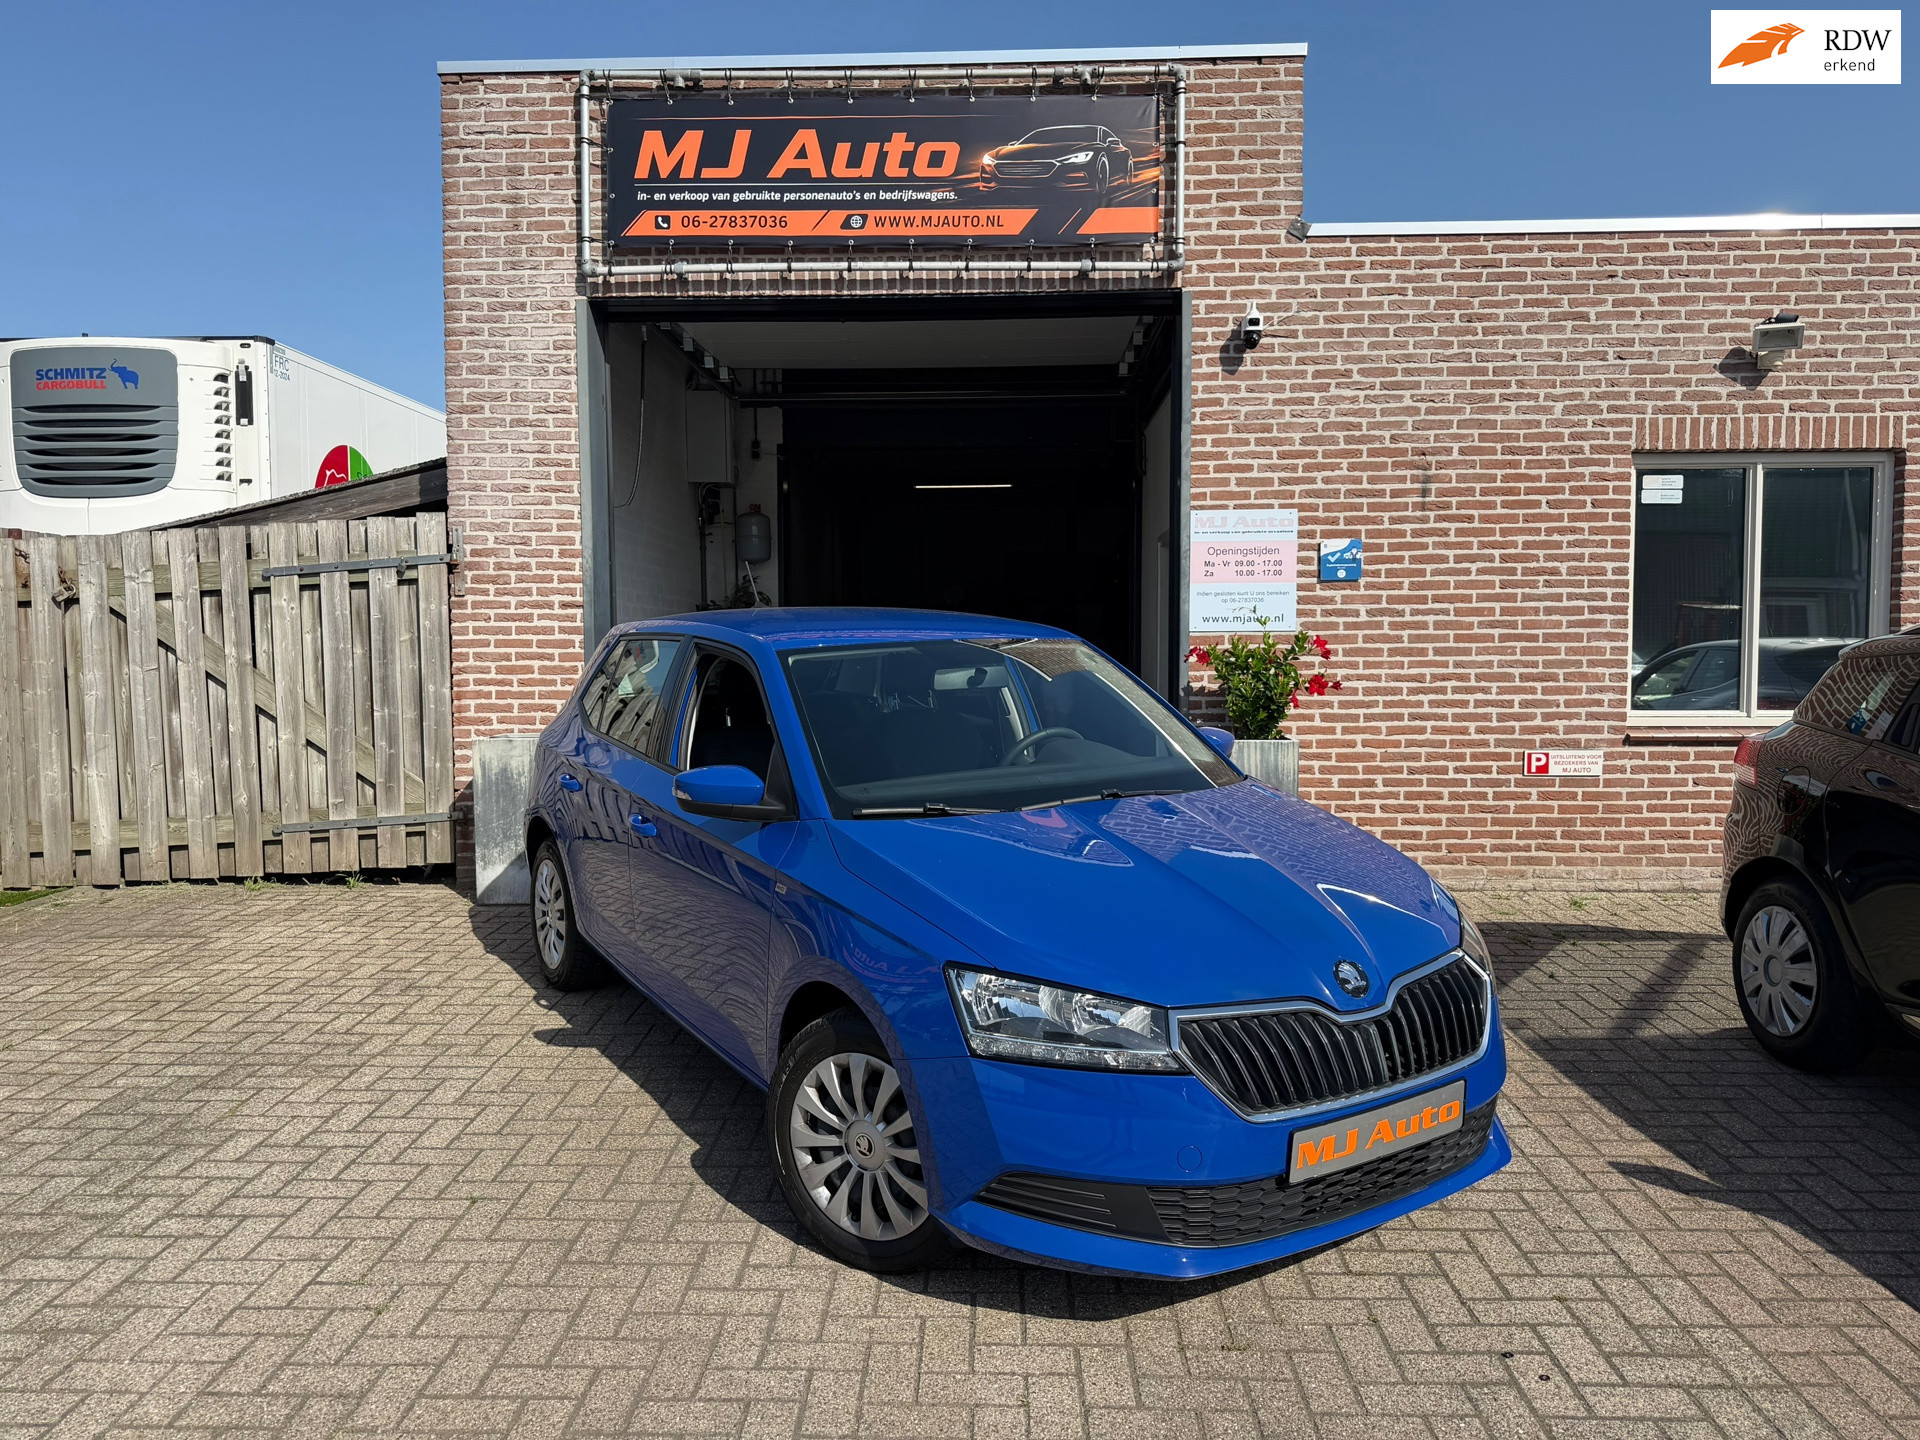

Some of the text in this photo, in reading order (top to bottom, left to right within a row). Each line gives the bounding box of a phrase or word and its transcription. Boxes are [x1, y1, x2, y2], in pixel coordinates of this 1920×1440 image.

[633, 128, 961, 179] MJ Auto
[637, 190, 958, 203] in- en verkoop van gebruikte personenauto's en bedrijfswagens.
[681, 215, 1004, 229] 06-27837036 WWW.MJAUTO.NL
[274, 354, 290, 372] FRC
[35, 367, 107, 381] SCHMITZ
[35, 380, 107, 391] CARGOBULL
[1194, 516, 1294, 528] MJ Auto
[1207, 546, 1280, 557] Openingstijden
[1213, 590, 1237, 598] gesloten
[1531, 753, 1547, 773] P
[1297, 1100, 1460, 1169] MJ Auto
